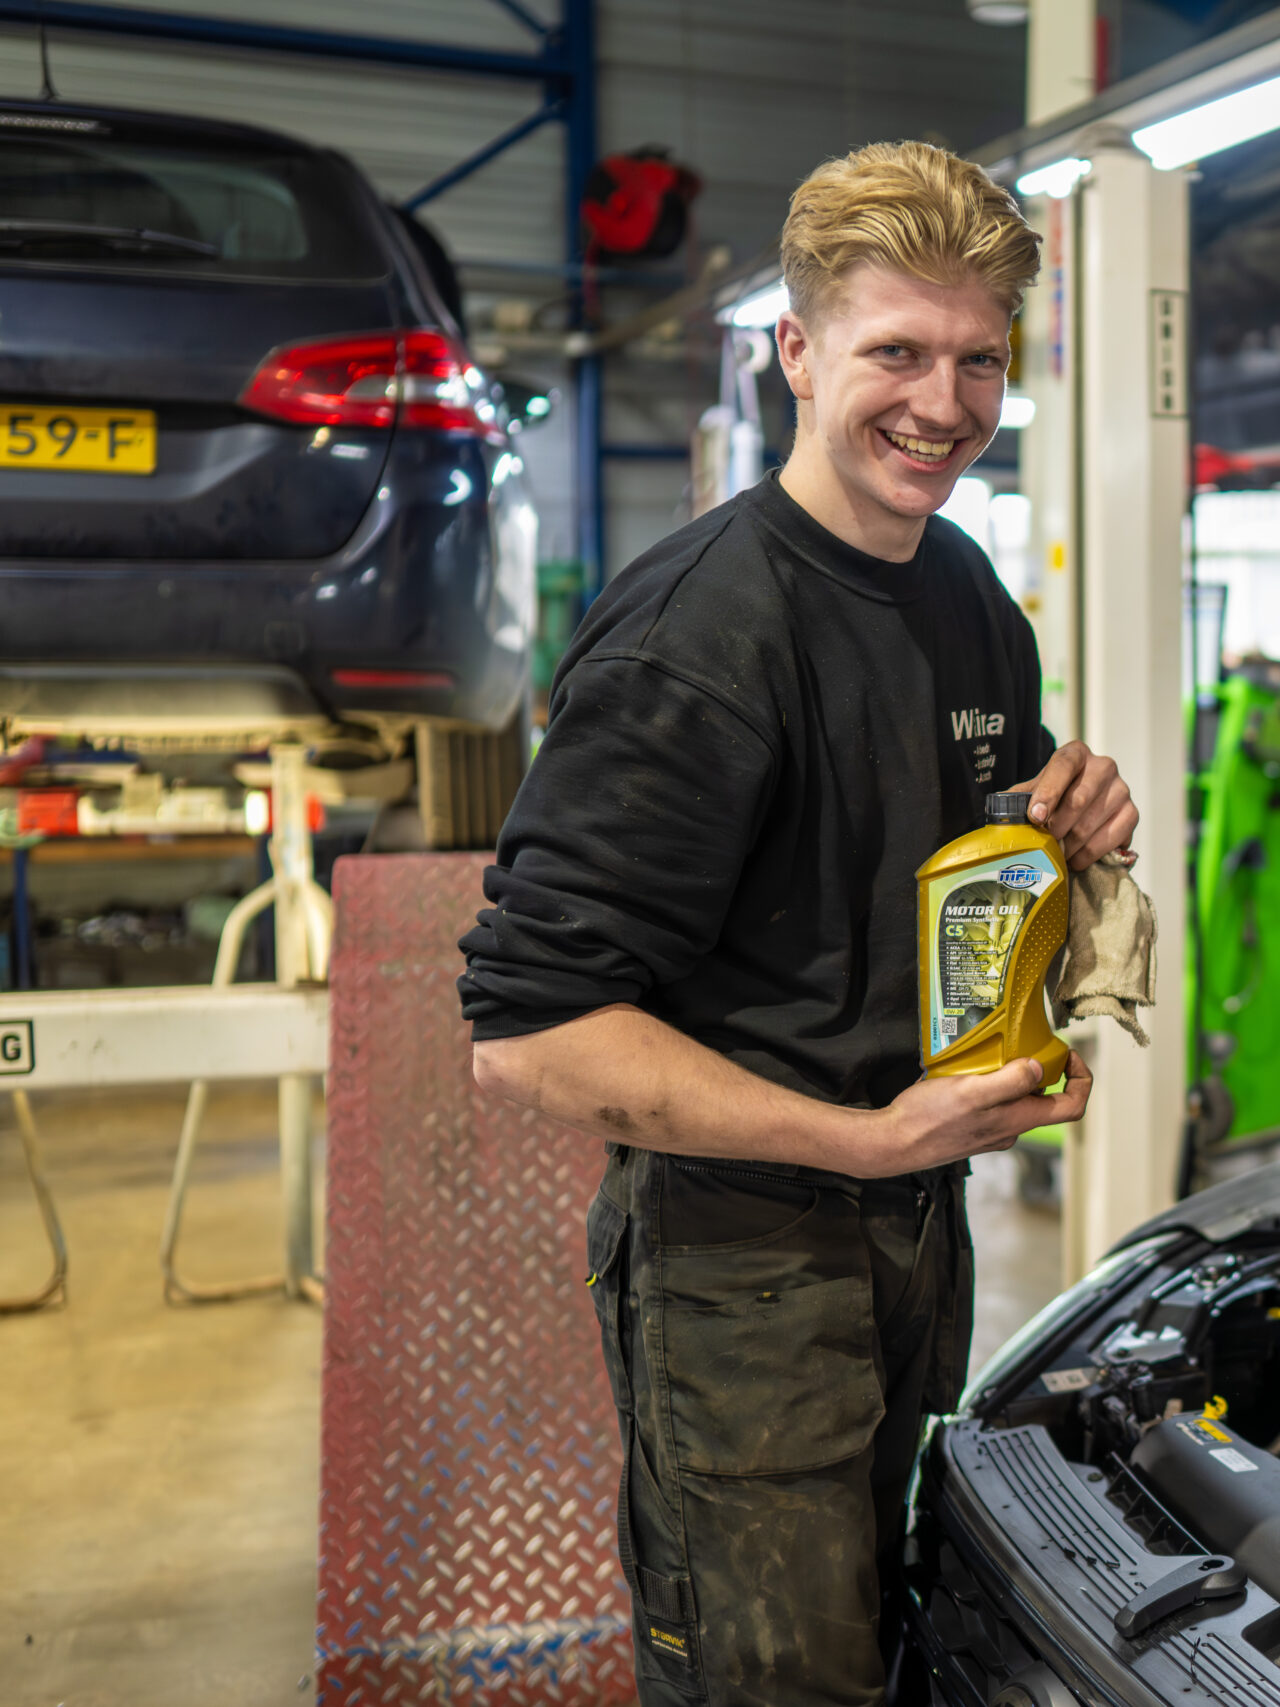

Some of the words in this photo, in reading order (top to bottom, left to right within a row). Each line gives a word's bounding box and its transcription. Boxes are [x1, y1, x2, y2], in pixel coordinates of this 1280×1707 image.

[945, 905, 995, 916] MOTOR
[998, 905, 1021, 915] OIL
[945, 924, 964, 937] C5
[1, 1033, 22, 1062] G
